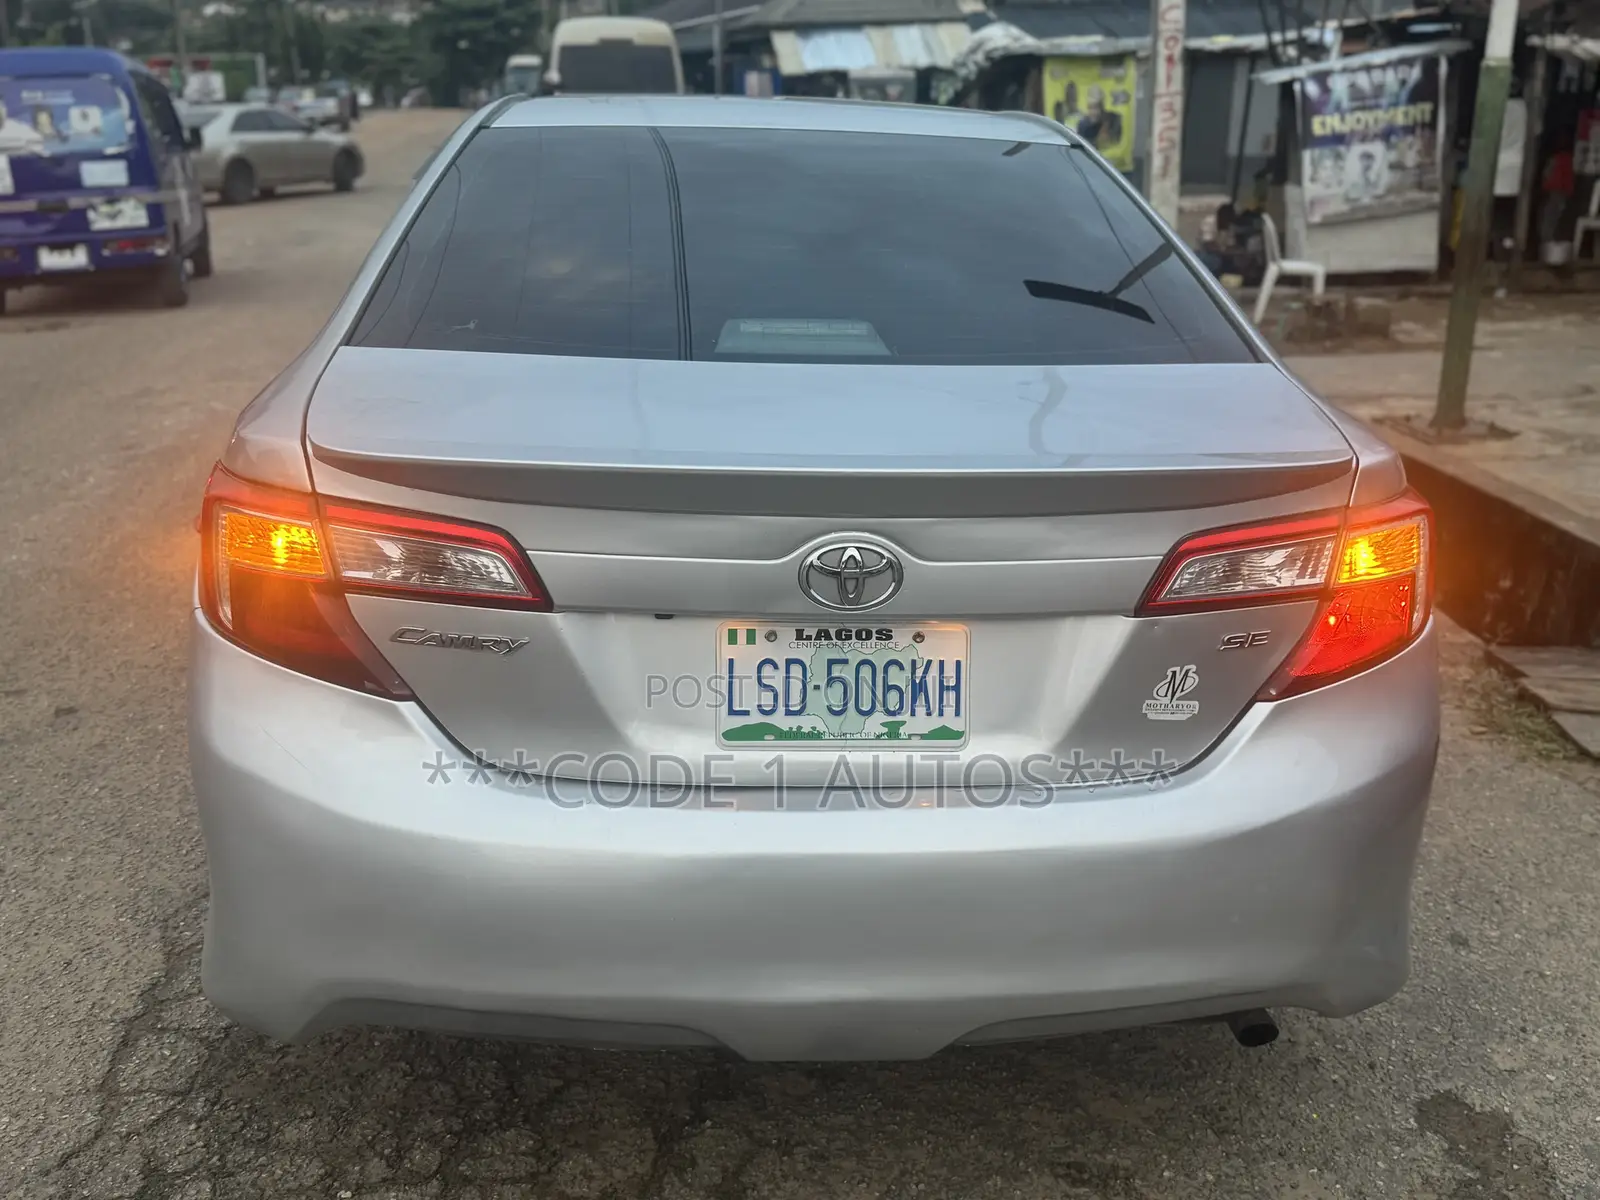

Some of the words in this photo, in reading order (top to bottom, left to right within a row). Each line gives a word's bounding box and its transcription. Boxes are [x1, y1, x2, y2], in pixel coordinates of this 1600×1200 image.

[1311, 102, 1434, 136] ENJOYMENT
[390, 626, 530, 656] CAMRY
[788, 641, 825, 649] CENTRE
[826, 641, 840, 649] OF
[841, 641, 900, 649] EXCELLENCE
[794, 628, 893, 641] LAGOS
[1217, 629, 1271, 651] SE
